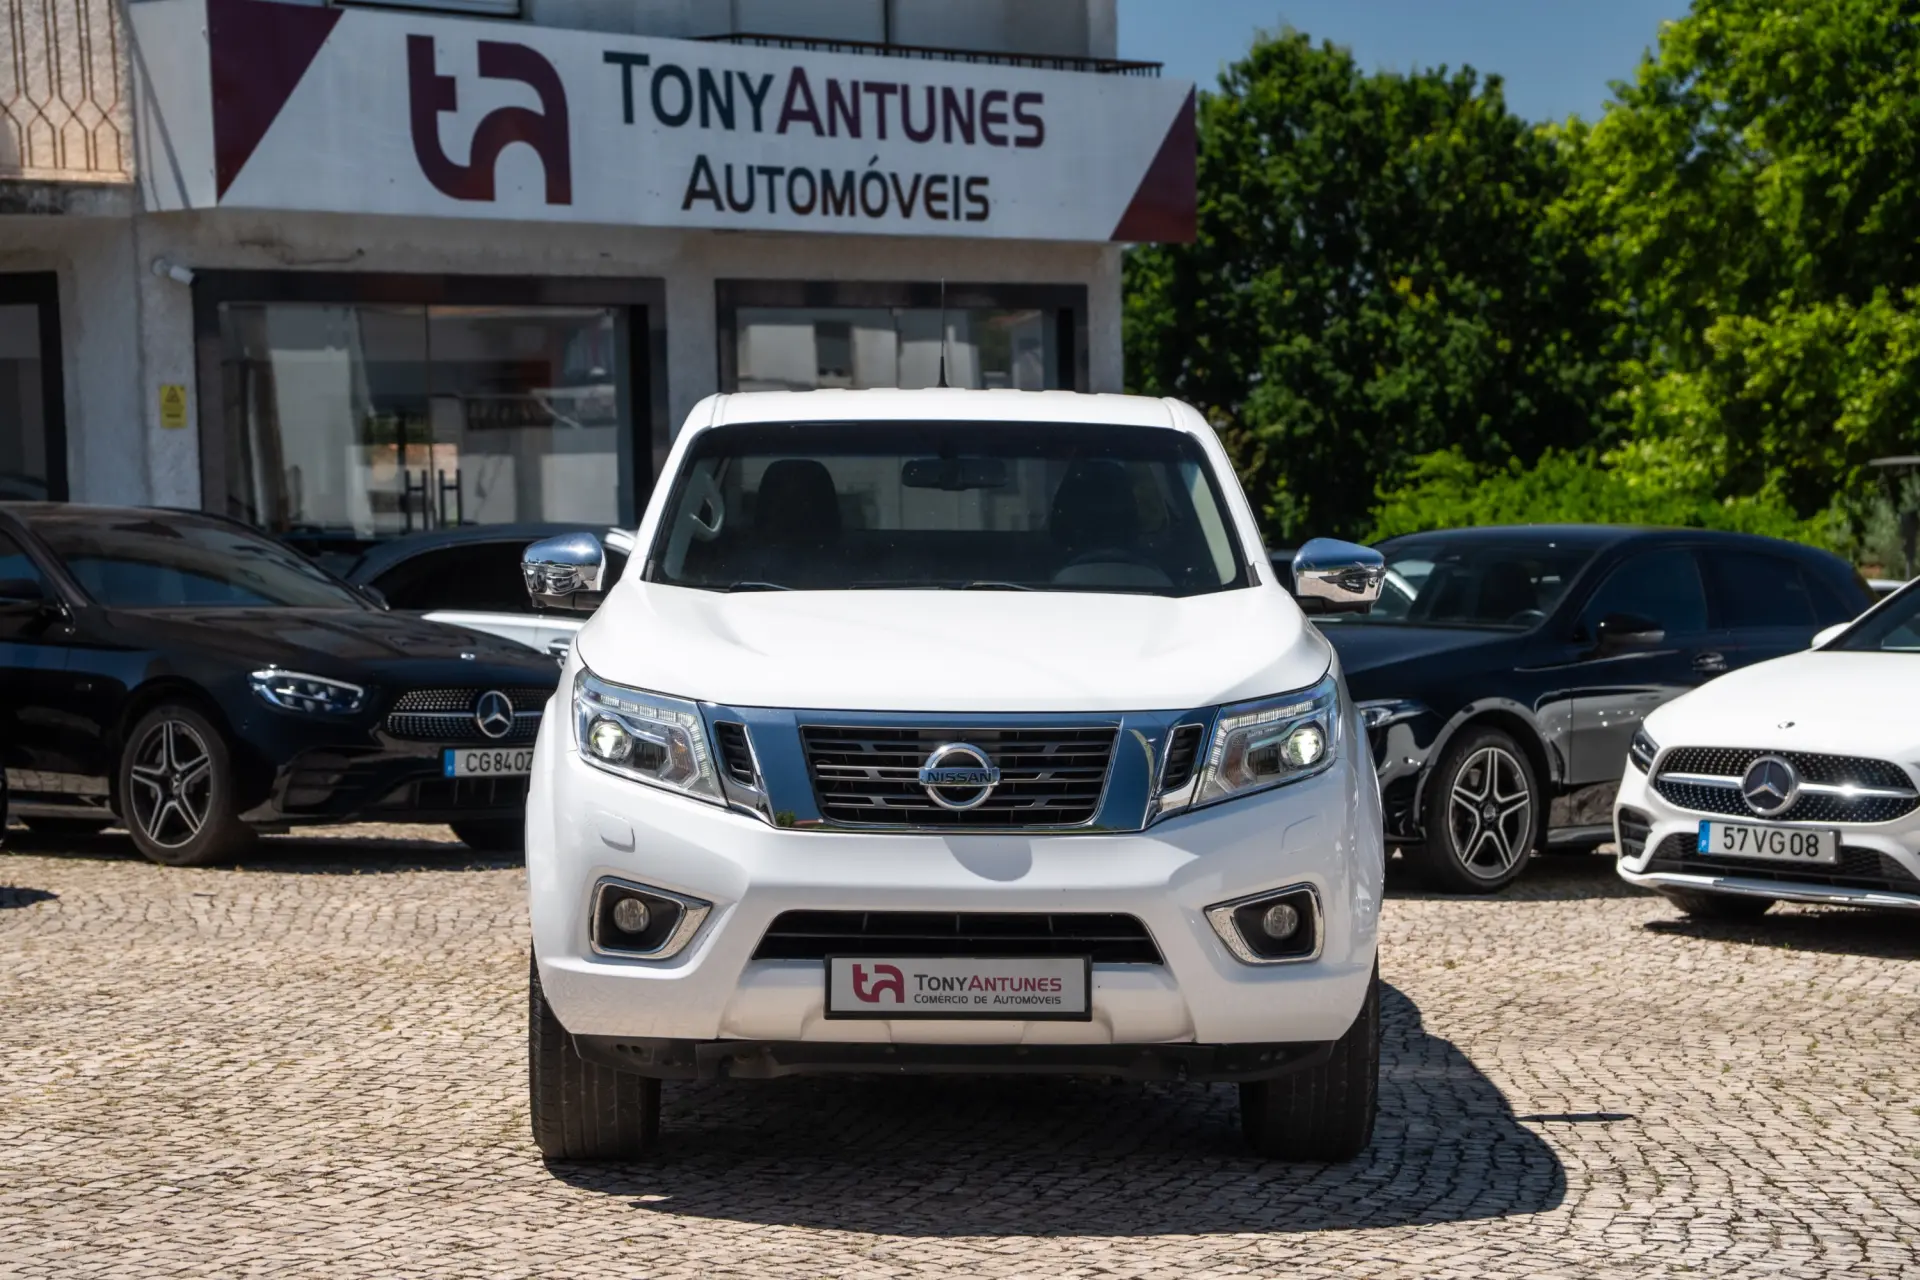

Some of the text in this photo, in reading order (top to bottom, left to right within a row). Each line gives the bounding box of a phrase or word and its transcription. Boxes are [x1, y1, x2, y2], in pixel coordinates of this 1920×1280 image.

[682, 154, 989, 222] AUTOMÓVEIS
[928, 772, 992, 783] NISSAN
[914, 994, 968, 1004] COMÉRCIO
[993, 995, 1062, 1005] AUTOMÓVEIS
